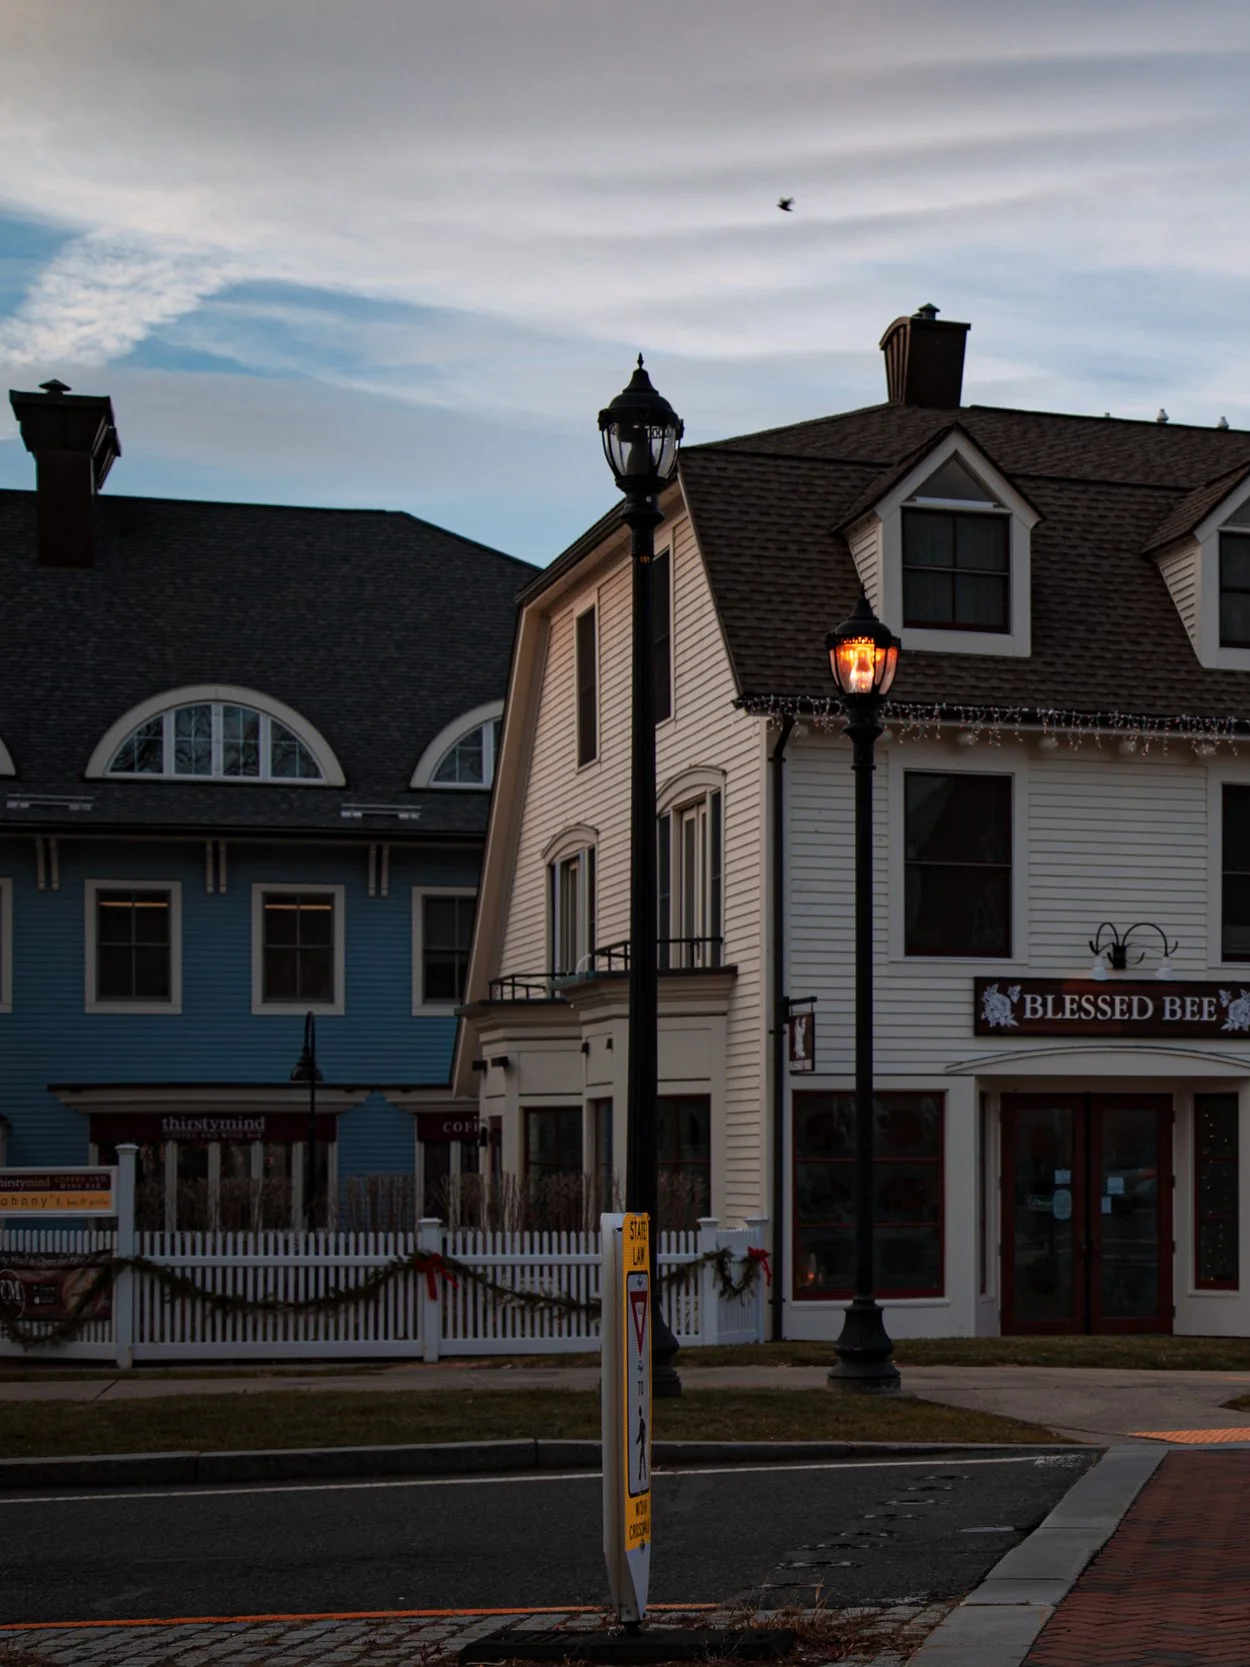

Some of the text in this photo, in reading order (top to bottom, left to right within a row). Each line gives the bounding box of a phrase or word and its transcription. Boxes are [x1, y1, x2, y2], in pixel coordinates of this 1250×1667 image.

[1022, 994, 1218, 1022] BLESSED BEE
[161, 1115, 266, 1133] thirstymind
[0, 1175, 51, 1190] hirstymind
[0, 1194, 61, 1208] ohnny's
[629, 1220, 647, 1240] STATE
[632, 1246, 645, 1266] LAW
